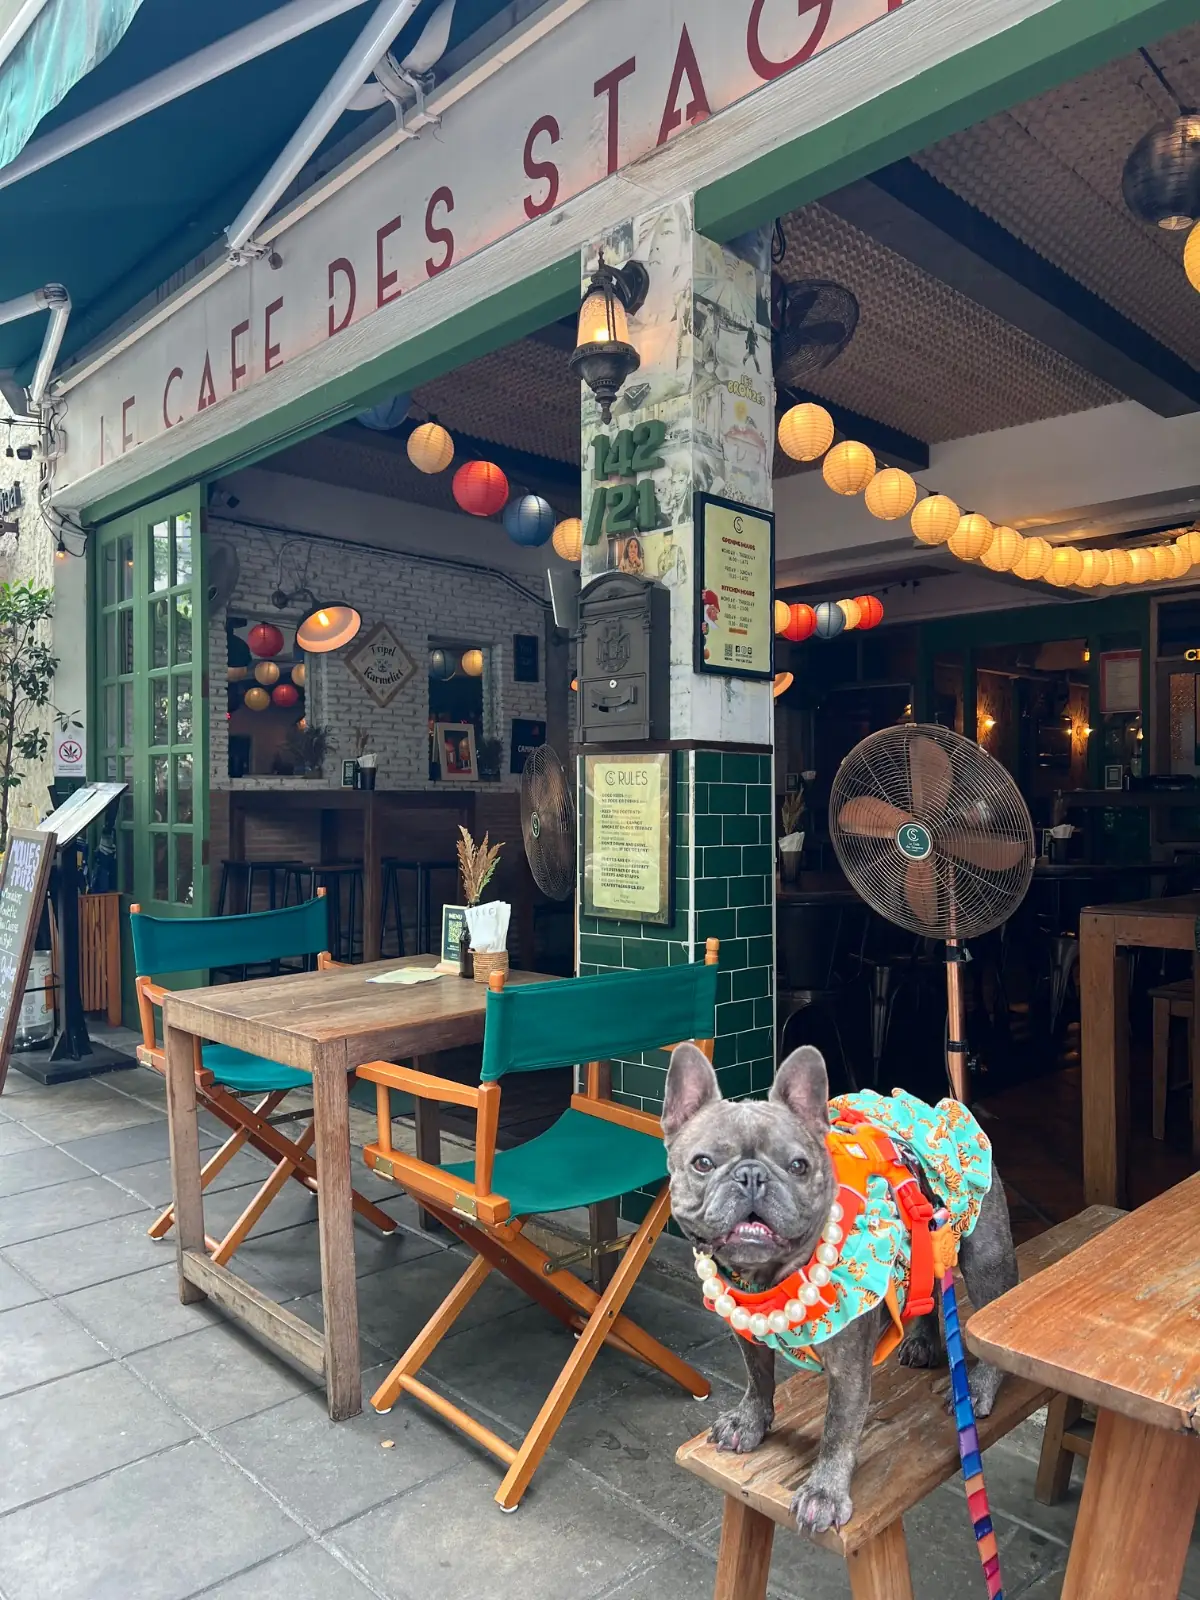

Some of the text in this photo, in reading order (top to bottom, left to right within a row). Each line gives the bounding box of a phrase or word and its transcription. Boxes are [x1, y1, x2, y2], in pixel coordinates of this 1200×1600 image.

[163, 297, 284, 429] CAFE
[328, 186, 455, 338] DES
[523, 0, 910, 220] STAG
[740, 374, 753, 388] LES
[591, 419, 666, 482] 142
[368, 643, 398, 657] Tripel
[363, 666, 404, 685] Karmeliet
[618, 770, 649, 786] RULES
[448, 912, 464, 921] MENU
